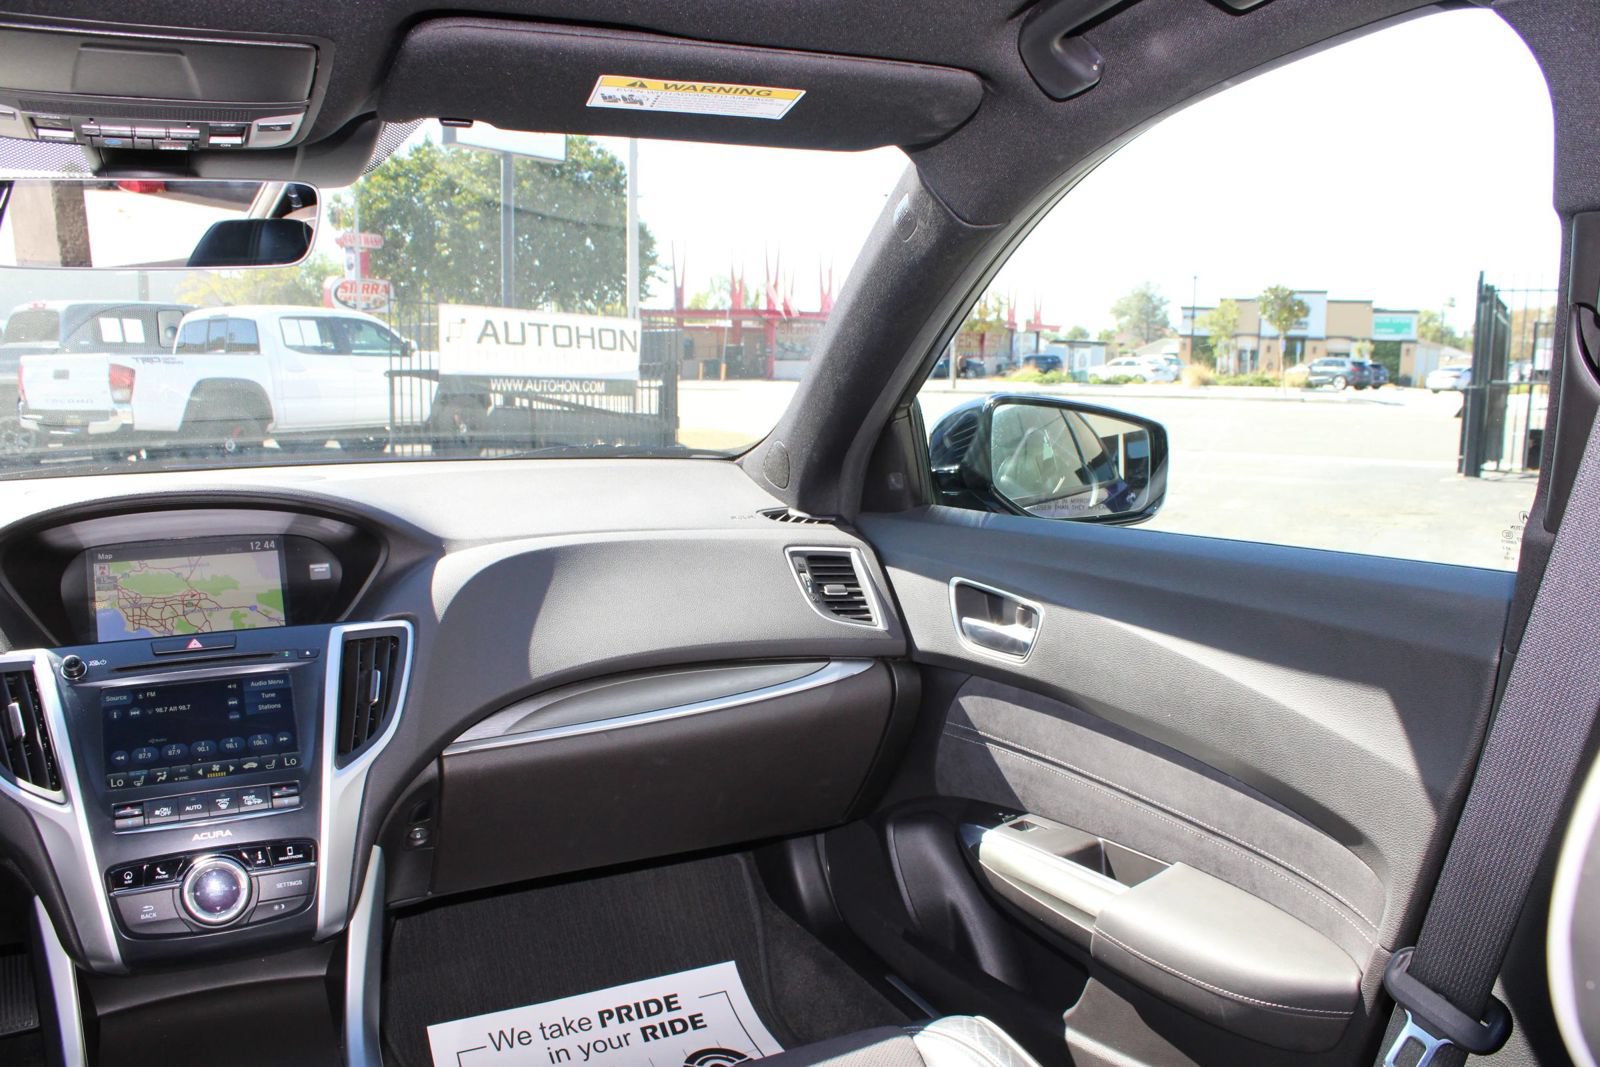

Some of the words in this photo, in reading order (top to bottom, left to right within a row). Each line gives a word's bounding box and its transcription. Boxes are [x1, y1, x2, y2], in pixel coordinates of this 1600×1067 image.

[663, 83, 774, 97] WARNING
[477, 319, 638, 353] AUTOHON
[490, 378, 606, 394] WWW.AUTOHON.COM
[97, 553, 113, 561] Map
[185, 804, 202, 812] AUTO
[192, 829, 233, 842] ACURA
[276, 880, 303, 889] SETTINGS
[140, 912, 157, 920] BACK
[488, 1027, 532, 1051] We
[539, 1016, 593, 1041] take
[598, 993, 682, 1028] PRIDE
[547, 1047, 571, 1064] in
[577, 1032, 631, 1061] your
[640, 1013, 707, 1042] RIDE
